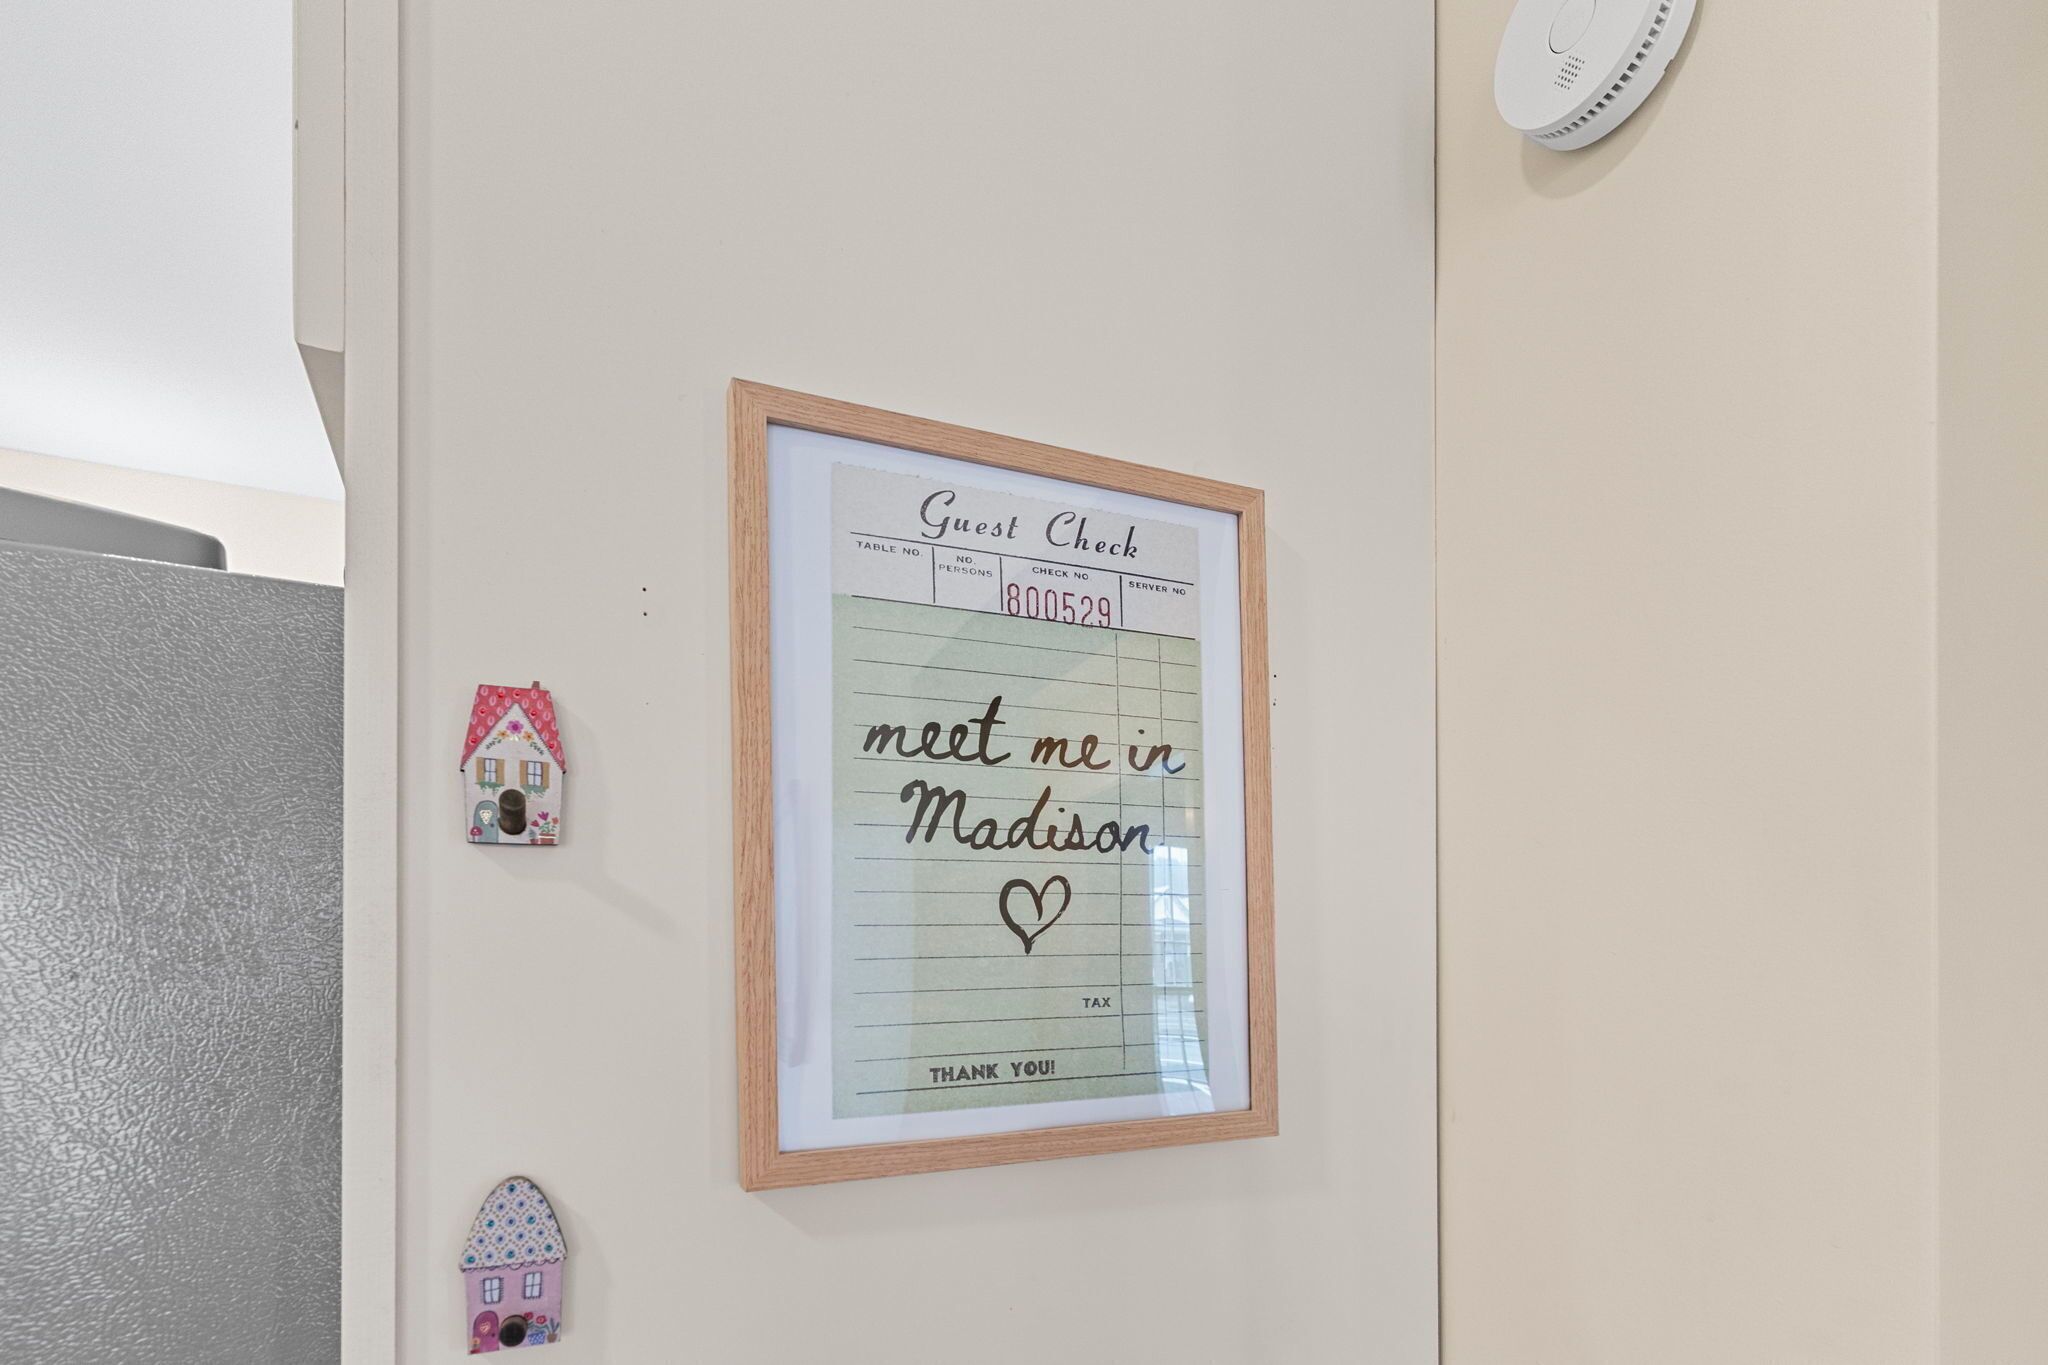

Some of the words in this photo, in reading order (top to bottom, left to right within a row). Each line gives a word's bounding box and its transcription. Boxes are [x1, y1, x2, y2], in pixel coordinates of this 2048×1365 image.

[919, 489, 1019, 539] Guest
[1045, 511, 1138, 559] Check
[856, 540, 897, 554] TABLE
[903, 547, 923, 557] NO.
[956, 555, 976, 565] NO.
[938, 564, 993, 578] PERSONS
[1032, 566, 1069, 579] CHECK
[1128, 581, 1168, 593] SERVER
[1006, 582, 1112, 628] 800529
[863, 695, 1011, 765] meet
[1030, 734, 1112, 770] me
[1128, 729, 1186, 774] in
[900, 779, 1154, 855] Madison
[1082, 997, 1112, 1009] TAX
[929, 1062, 1000, 1083] THANK
[1010, 1059, 1056, 1078] YOU!
